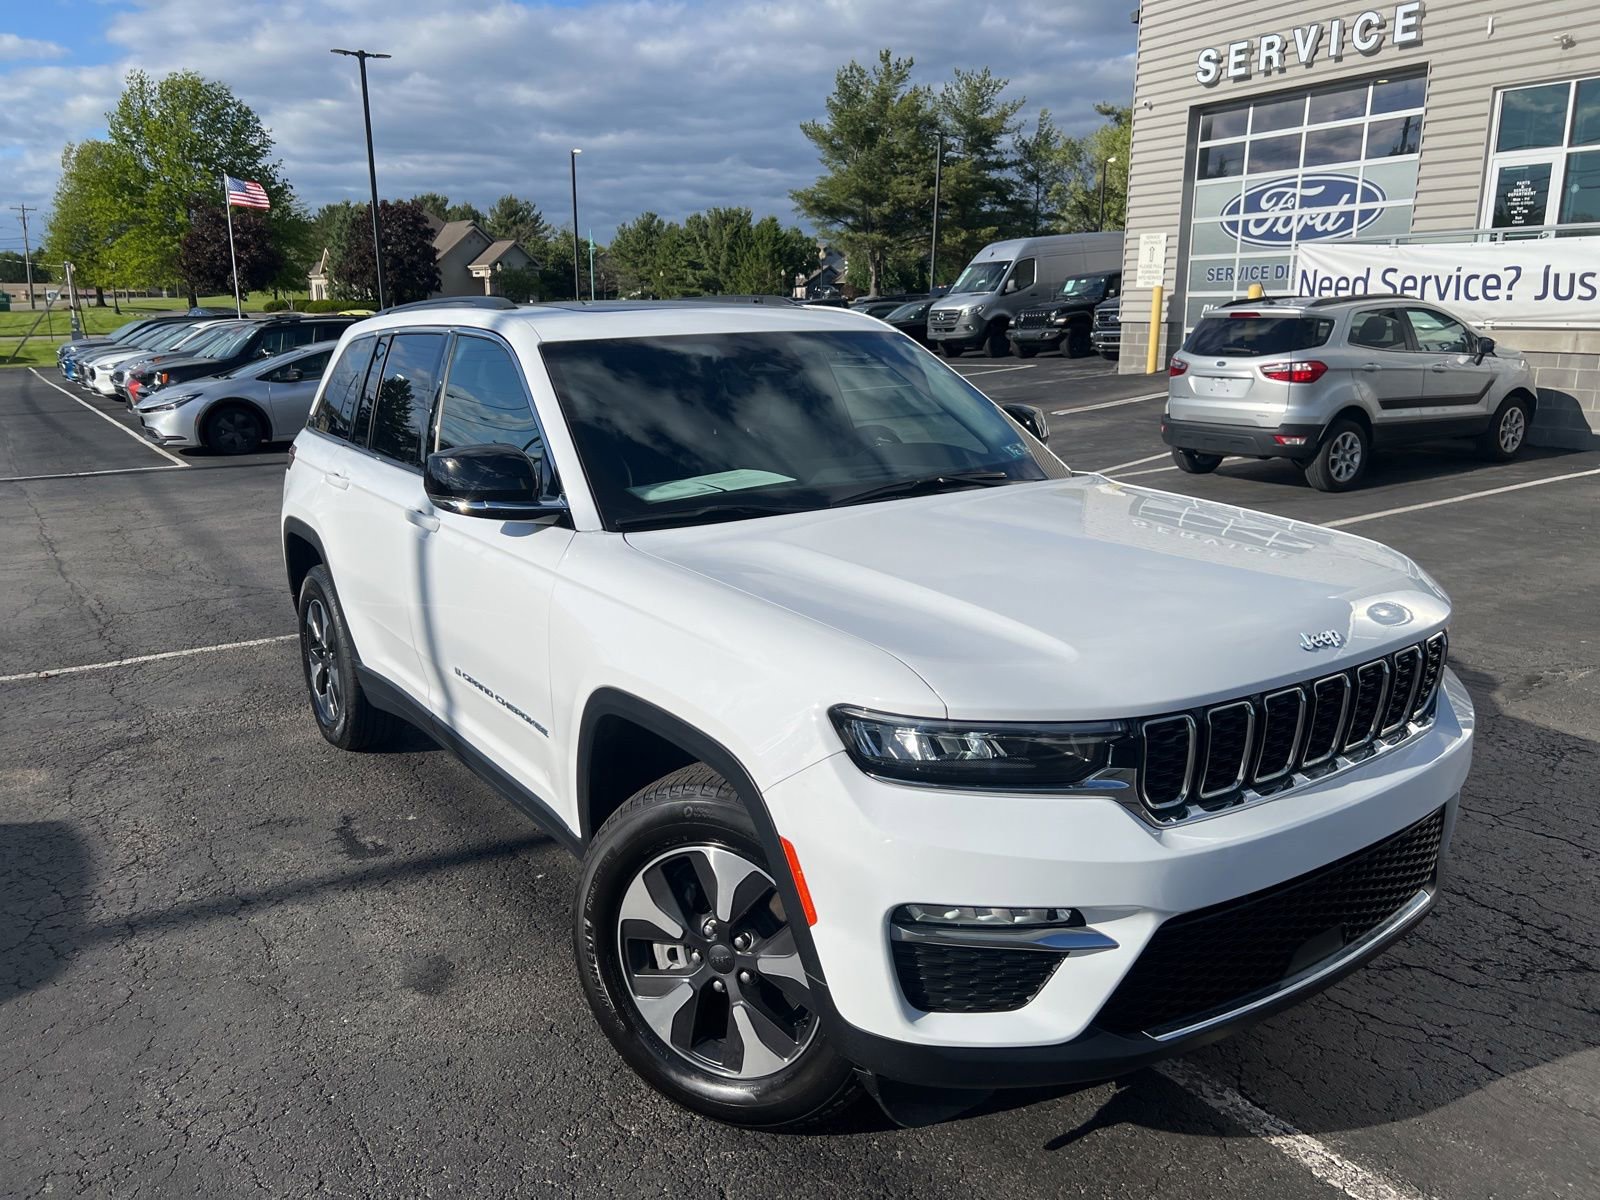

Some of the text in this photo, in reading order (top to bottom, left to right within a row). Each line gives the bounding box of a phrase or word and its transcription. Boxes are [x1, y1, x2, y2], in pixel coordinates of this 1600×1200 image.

[1196, 1, 1424, 85] SERVICE
[1248, 185, 1352, 236] Ford
[1207, 265, 1270, 282] SERVICE
[1299, 267, 1371, 297] Need
[1381, 265, 1523, 301] Service?
[1299, 629, 1341, 651] Jeep
[462, 672, 495, 699] GRAND
